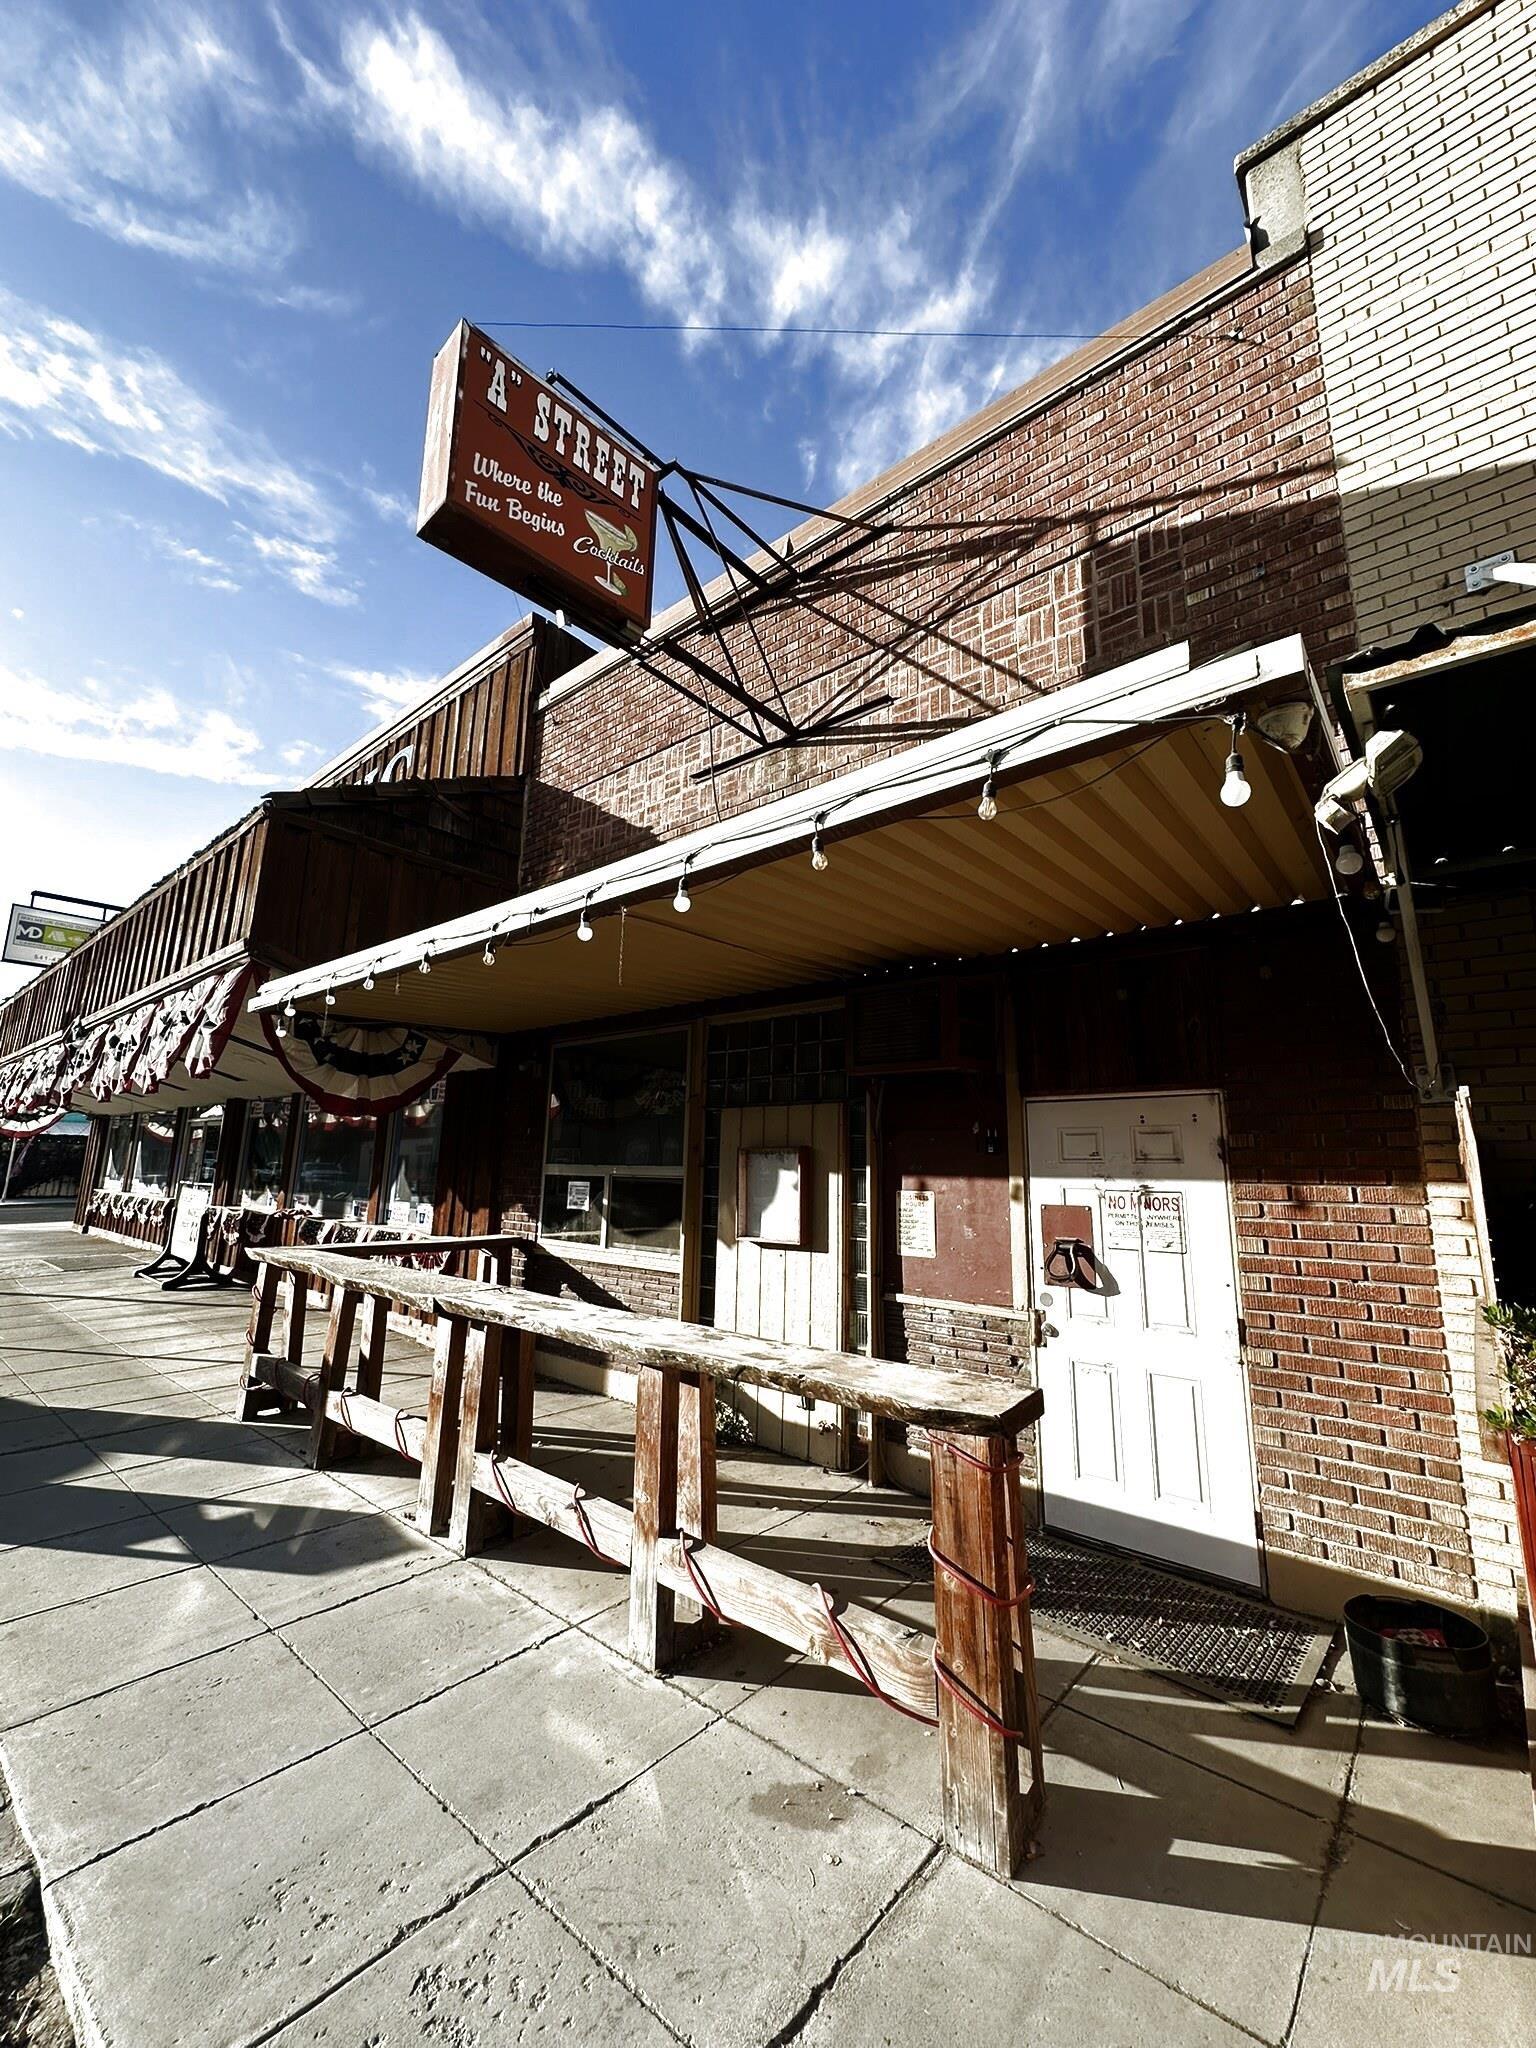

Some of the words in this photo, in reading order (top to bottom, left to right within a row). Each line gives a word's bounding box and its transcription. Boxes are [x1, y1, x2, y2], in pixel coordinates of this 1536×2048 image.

[533, 392, 646, 510] STREET
[473, 452, 532, 495] Where
[537, 481, 563, 507] the
[464, 481, 501, 512] Fun
[506, 498, 565, 536] Begins
[573, 536, 645, 575] Cocktails
[17, 924, 43, 939] MD
[1108, 1195, 1126, 1209] NO
